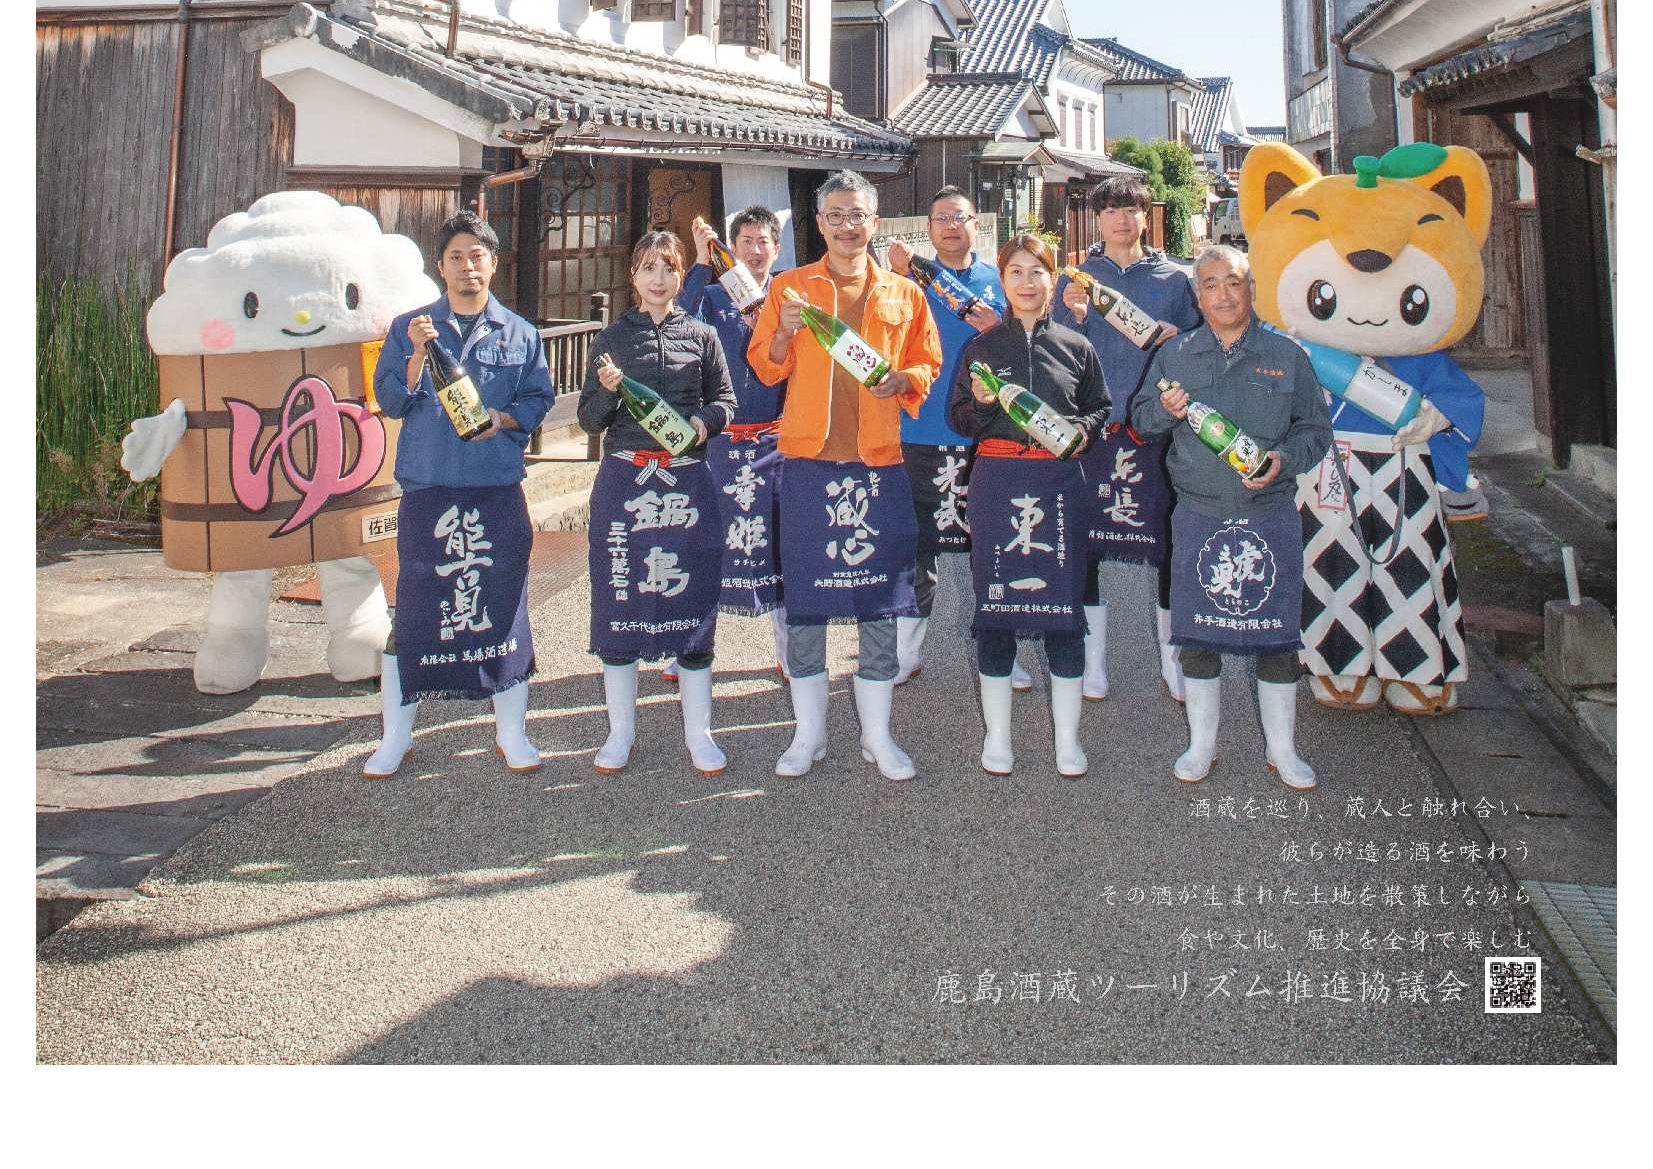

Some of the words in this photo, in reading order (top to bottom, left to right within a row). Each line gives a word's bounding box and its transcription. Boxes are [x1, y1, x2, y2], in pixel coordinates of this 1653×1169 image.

[1361, 365, 1408, 398] かしま
[221, 374, 387, 538] ゆ
[932, 455, 972, 535] 光武
[624, 489, 700, 598] 鍋島
[722, 464, 769, 557] 幸姫
[825, 475, 880, 566] 蔵心
[1003, 493, 1055, 591] 東一
[433, 504, 494, 632] 能古見
[733, 558, 767, 567] サチヒメ
[1193, 613, 1283, 630] 井手酒造有限会社
